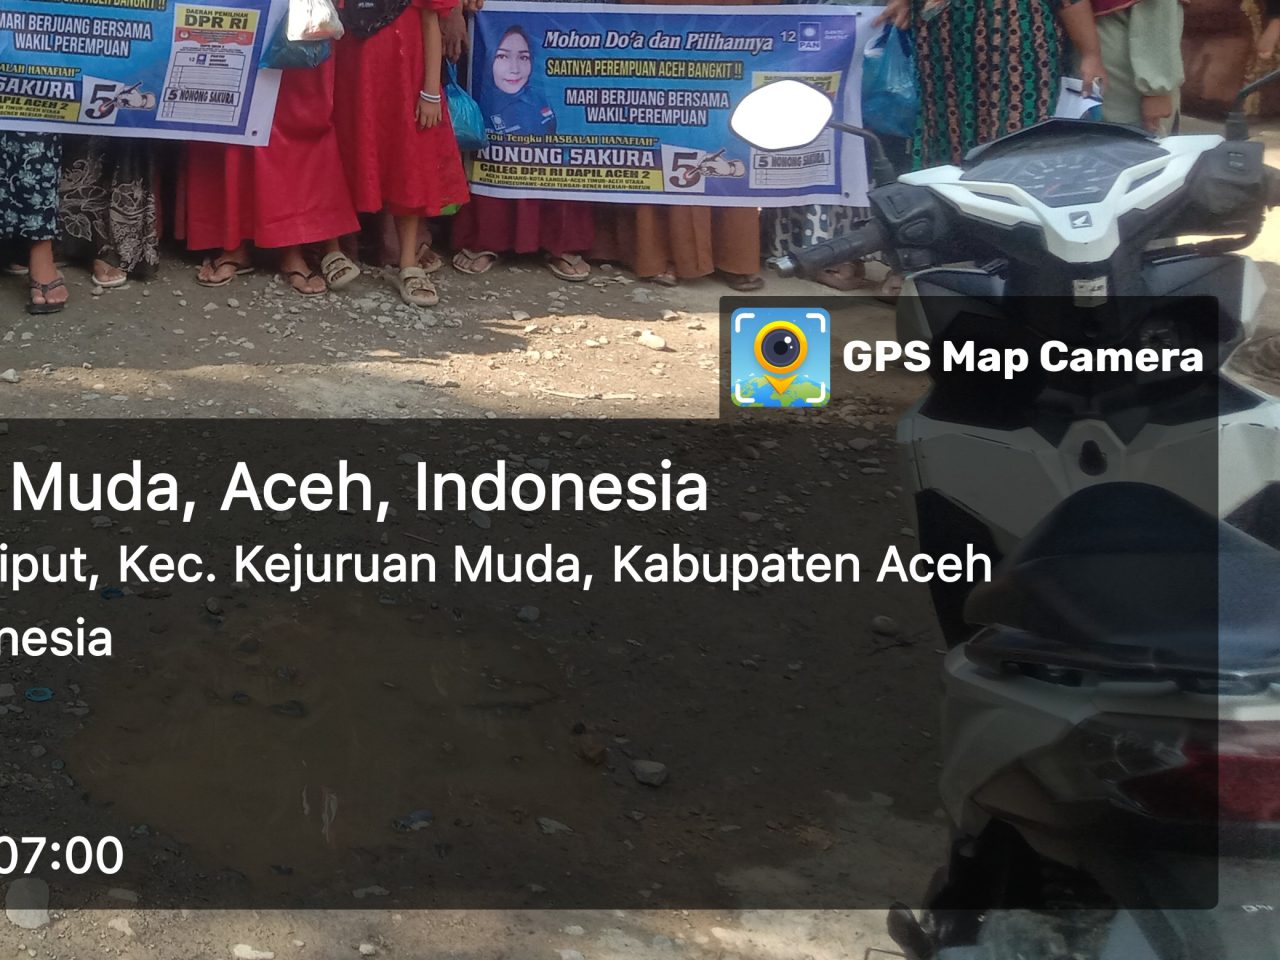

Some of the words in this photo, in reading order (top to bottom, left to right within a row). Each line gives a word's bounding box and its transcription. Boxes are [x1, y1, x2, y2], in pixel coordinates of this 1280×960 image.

[29, 15, 90, 34] BERJUANG
[93, 21, 151, 40] BERSAMA
[185, 14, 223, 28] DPR
[229, 19, 248, 29] RI
[15, 33, 52, 50] WAKIL
[55, 35, 129, 56] PEREMPUAN
[544, 32, 600, 48] Mohon
[605, 32, 643, 48] Do'a
[649, 32, 680, 49] dan
[686, 34, 773, 54] Pilihannya
[780, 31, 796, 42] 12
[800, 41, 820, 49] PAN
[547, 60, 592, 76] SAATNYA
[595, 60, 657, 76] PEREMPUAN
[659, 61, 685, 77] ACEH
[688, 62, 733, 78] BANGKIT
[24, 98, 57, 109] ACEH
[85, 84, 116, 120] 5
[566, 90, 597, 105] MARI
[602, 90, 665, 106] BERJUANG
[668, 92, 729, 107] BERSAMA
[587, 107, 626, 122] WAKIL
[629, 108, 706, 125] PEREMPUAN
[570, 148, 654, 166] SAKURA
[480, 163, 517, 174] CALEG
[521, 167, 546, 175] DPR
[550, 168, 562, 176] RI
[566, 169, 602, 177] DAPIL
[605, 169, 639, 178] ACEH
[642, 170, 651, 179] 2
[669, 152, 700, 188] 5
